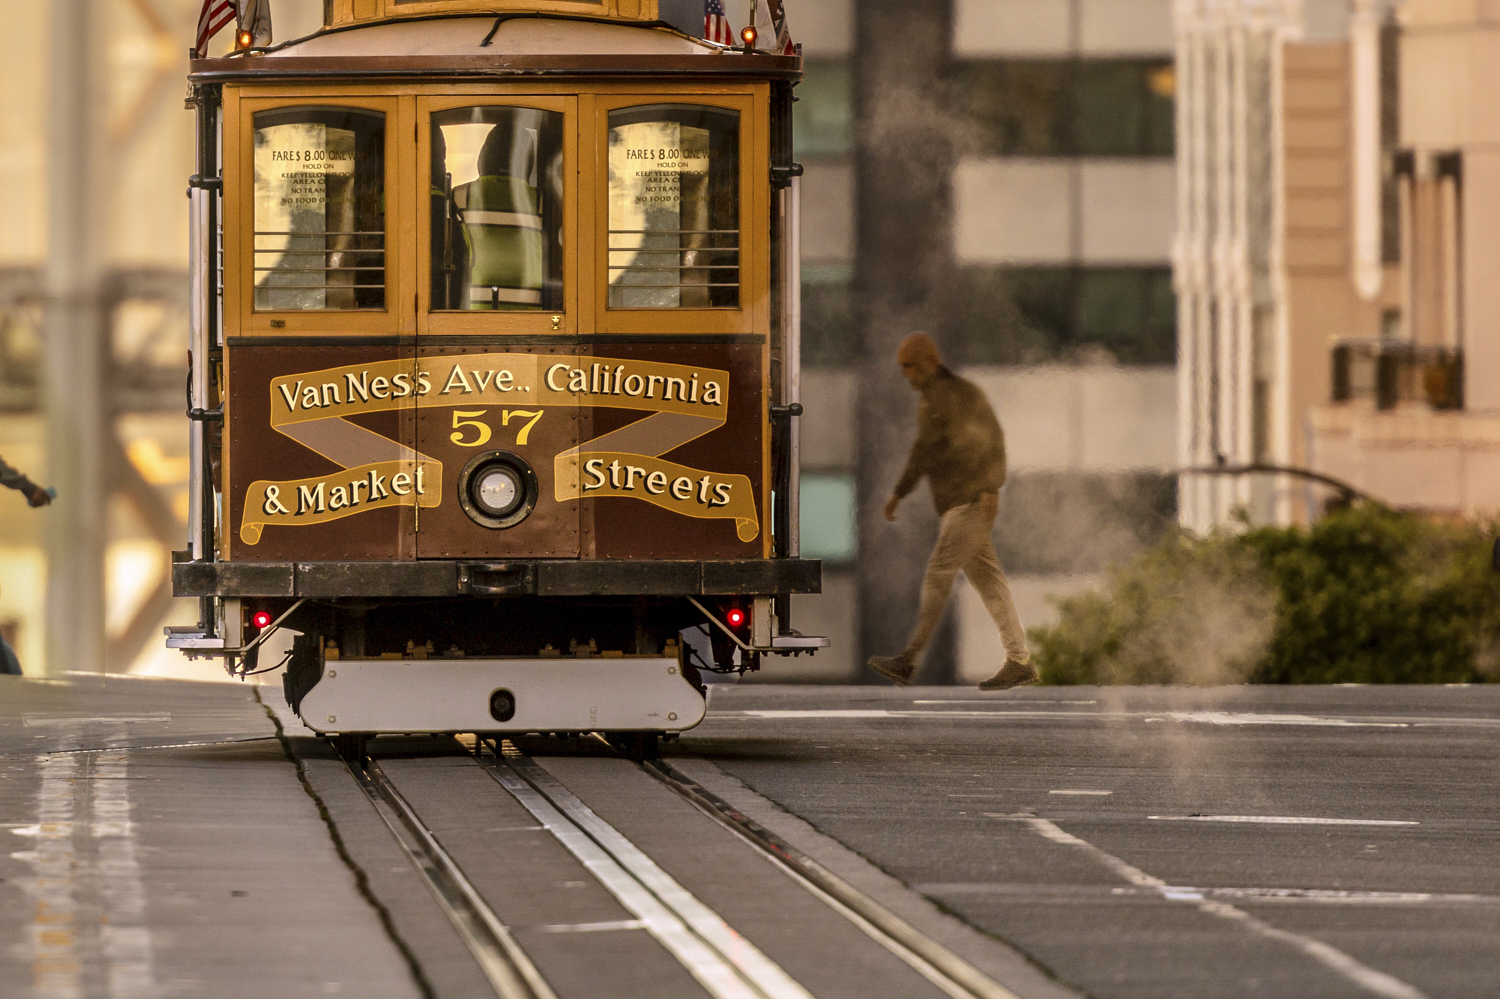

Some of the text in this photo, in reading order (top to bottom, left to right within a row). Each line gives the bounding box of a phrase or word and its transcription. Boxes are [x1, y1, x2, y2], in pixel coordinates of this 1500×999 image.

[304, 150, 325, 161] 8.00
[328, 150, 346, 161] ONE
[658, 148, 679, 160] 8.00
[682, 148, 701, 159] ONE
[279, 380, 341, 412] Van
[343, 370, 432, 403] Ness
[545, 362, 722, 405] California
[450, 409, 544, 447] 57
[263, 457, 733, 516] & Market Streets
